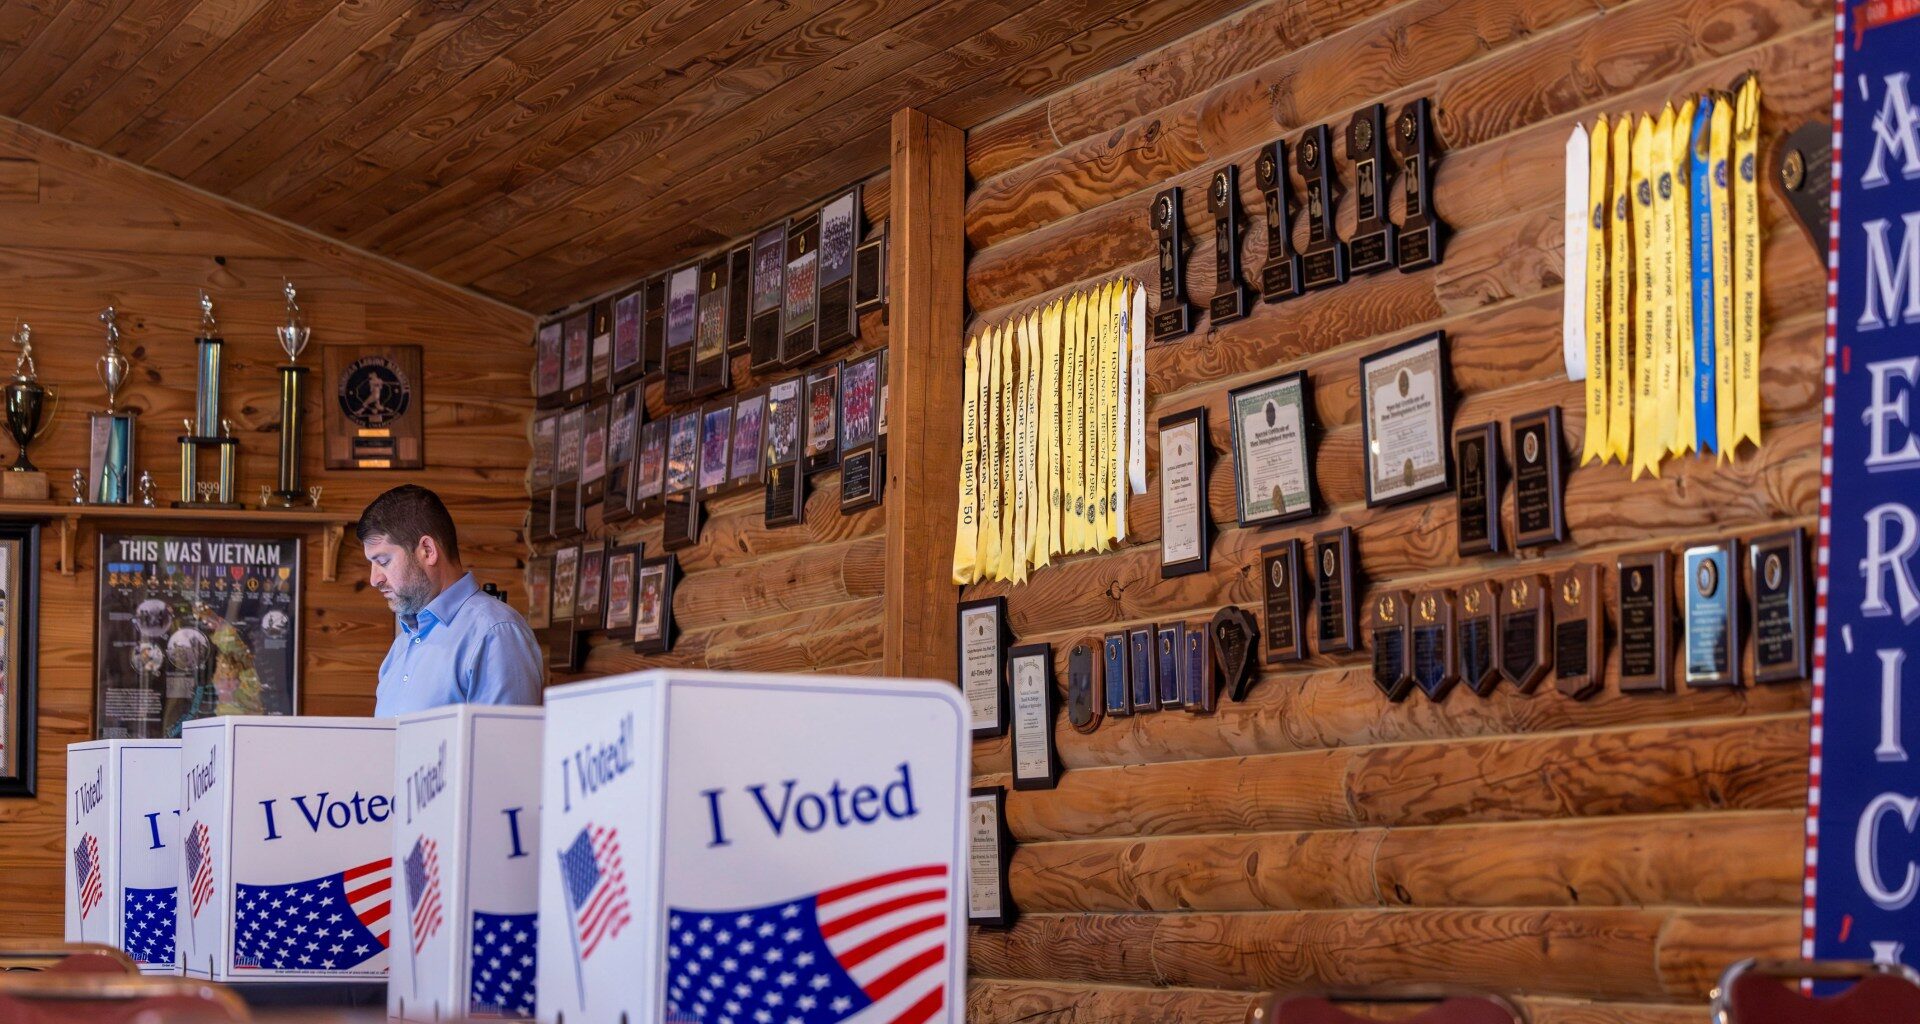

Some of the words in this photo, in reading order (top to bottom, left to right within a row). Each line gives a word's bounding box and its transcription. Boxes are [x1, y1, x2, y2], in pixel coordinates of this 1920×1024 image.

[967, 400, 975, 443] HONOR
[197, 481, 220, 494] 1999
[310, 486, 323, 497] 97
[965, 450, 974, 496] RIBBON
[963, 502, 974, 525] '50
[1855, 72, 1920, 965] AMERIC
[119, 540, 158, 562] THIS
[164, 541, 201, 563] WAS
[208, 543, 281, 566] VIETNAM
[185, 773, 192, 812] I
[191, 744, 217, 800] Voted!
[406, 776, 413, 825] I
[412, 739, 448, 811] Voted!
[561, 756, 573, 814] I
[572, 712, 635, 802] Voted!
[74, 788, 81, 825] I
[80, 764, 104, 814] Voted!
[699, 789, 733, 849] I
[746, 762, 921, 838] Voted
[144, 811, 166, 851] I
[259, 798, 283, 842] I
[500, 806, 529, 859] I
